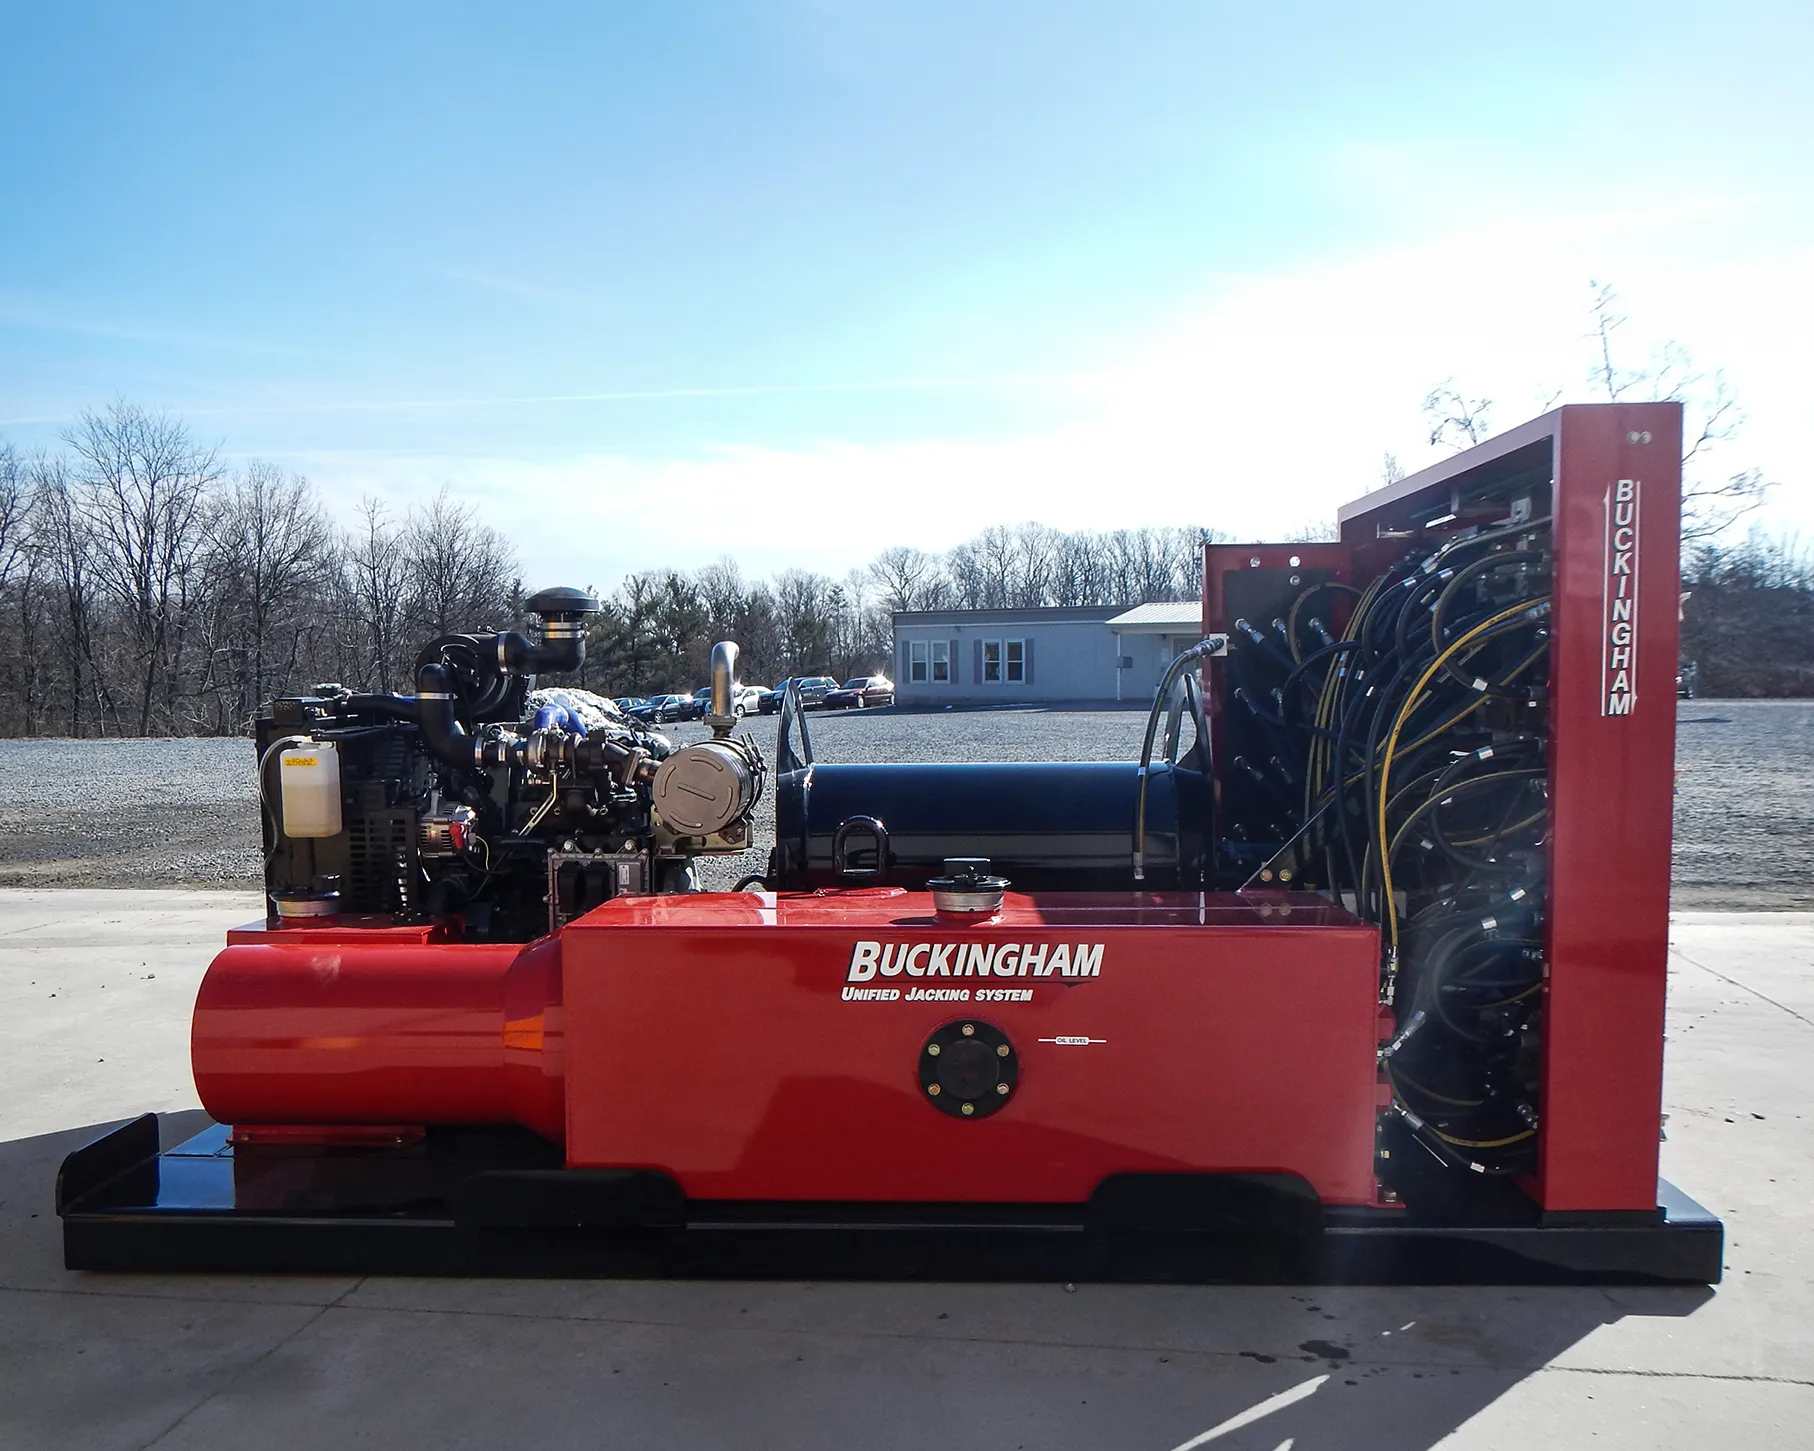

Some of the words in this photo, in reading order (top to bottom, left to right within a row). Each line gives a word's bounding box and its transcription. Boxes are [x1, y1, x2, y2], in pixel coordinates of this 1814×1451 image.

[1608, 479, 1634, 716] BUCKINGHAM
[846, 941, 1105, 982] BUCKINGHAM
[841, 986, 900, 1001] UNIFIED
[905, 986, 969, 1001] JACKING
[974, 988, 1033, 1001] SYSTEM
